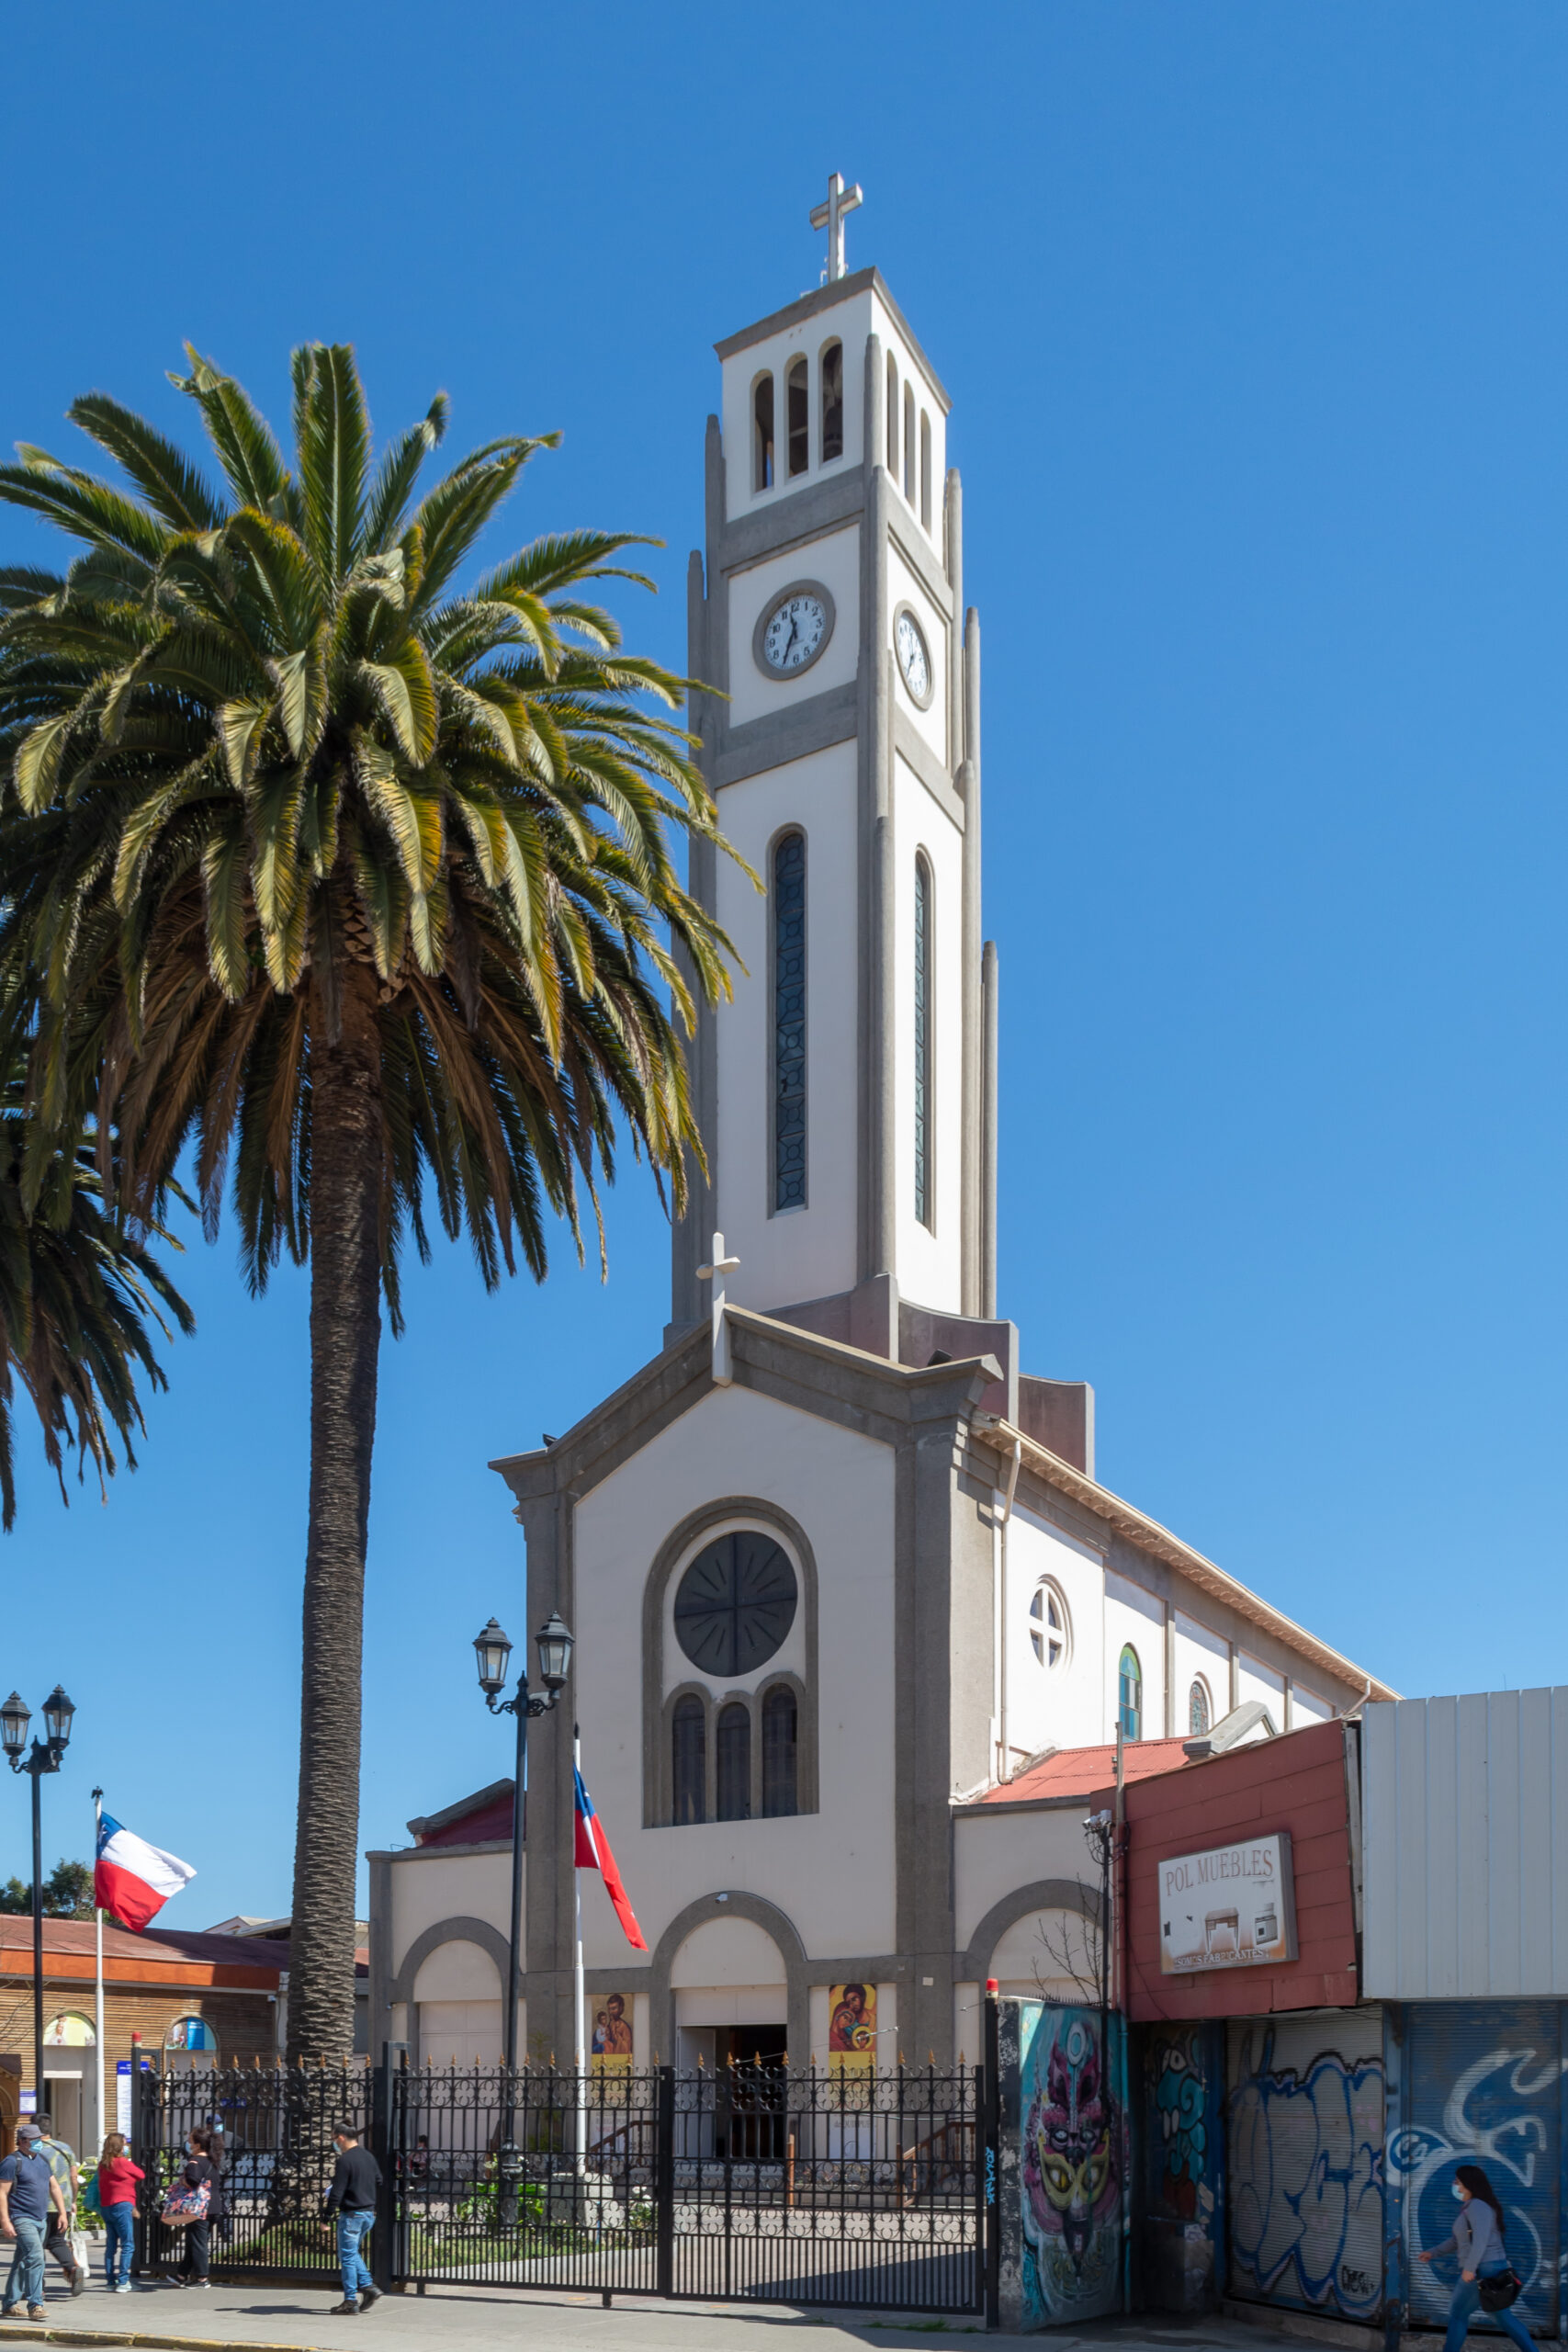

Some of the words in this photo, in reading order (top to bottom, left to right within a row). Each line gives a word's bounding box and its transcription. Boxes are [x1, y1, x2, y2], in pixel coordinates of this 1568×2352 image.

[790, 601, 800, 613] 12
[811, 606, 819, 617] 2
[815, 617, 823, 628] 3
[811, 632, 818, 642] 4
[769, 638, 776, 649] 9
[773, 649, 780, 660] 8
[793, 653, 800, 663] 6
[1166, 1863, 1194, 1897] POL
[1197, 1849, 1273, 1884] MUEBLES
